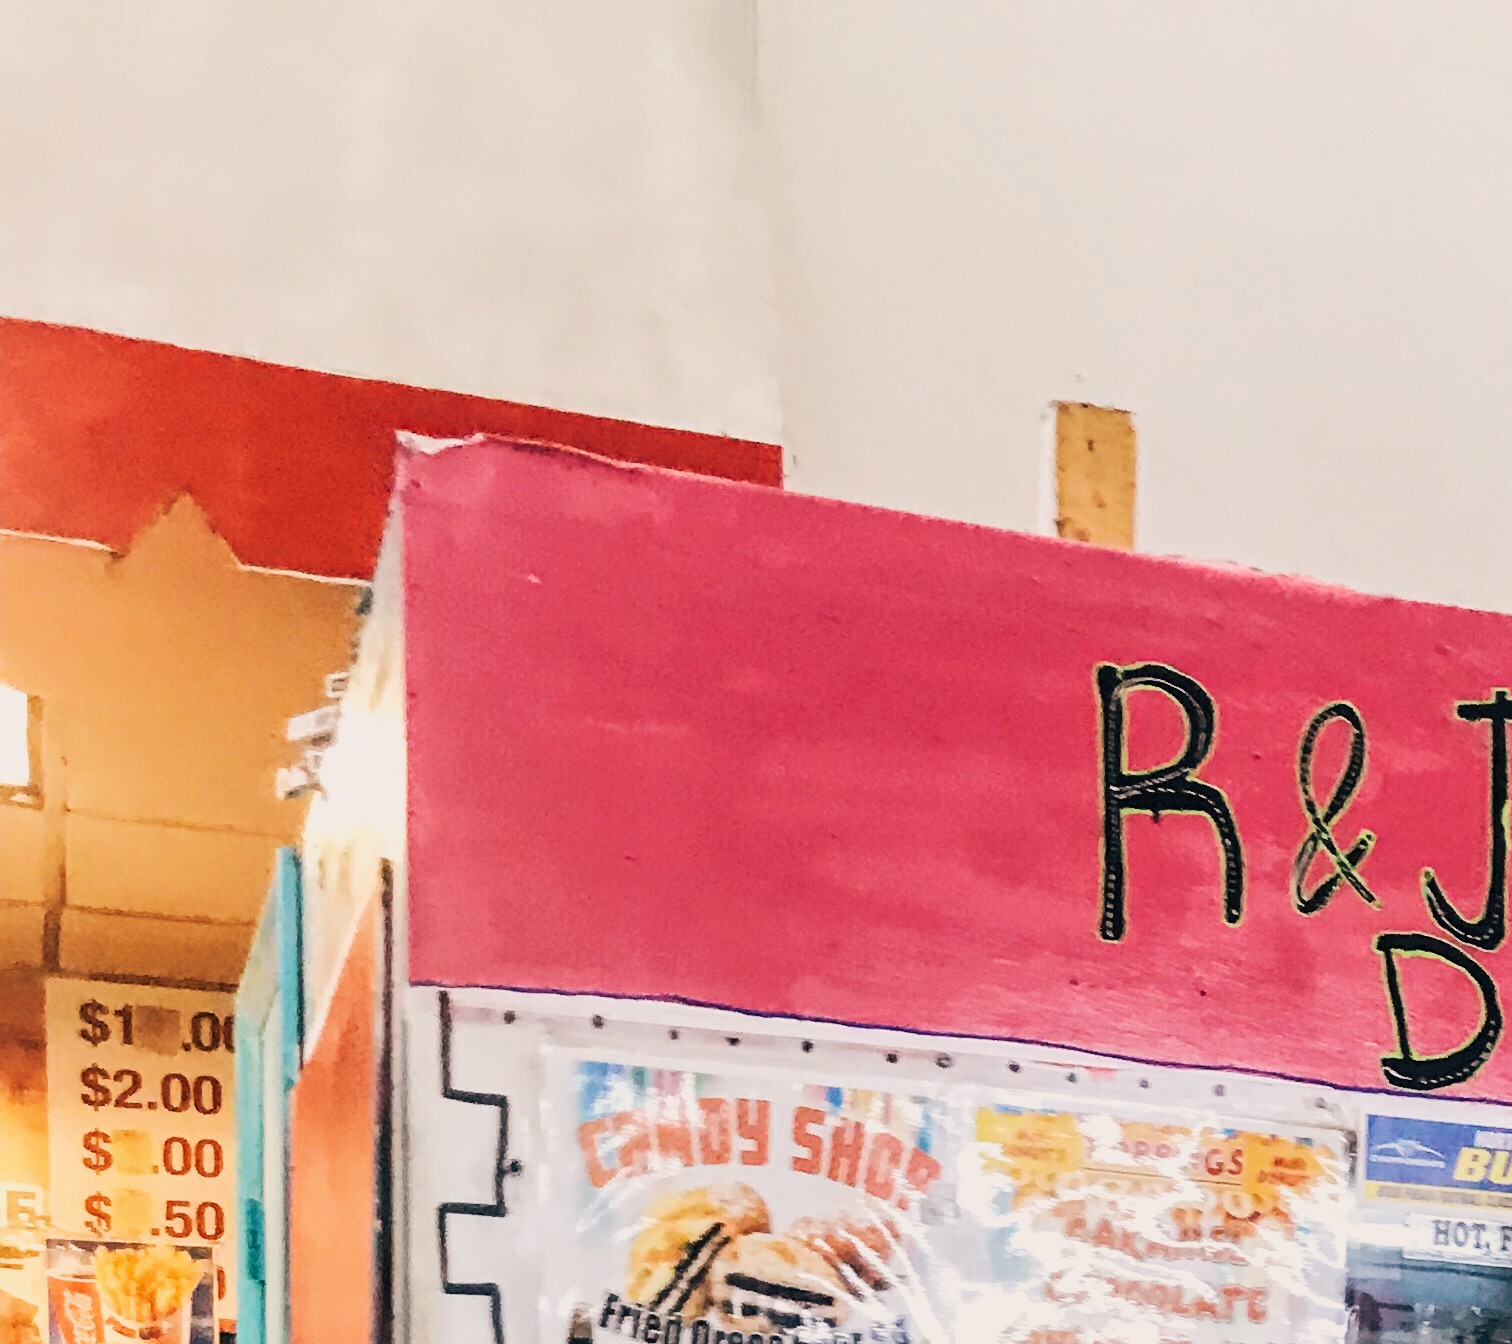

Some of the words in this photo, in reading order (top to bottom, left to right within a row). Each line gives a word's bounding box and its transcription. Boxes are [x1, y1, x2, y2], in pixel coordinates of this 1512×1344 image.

[81, 1063, 222, 1114] $2.00
[82, 1128, 224, 1178] $.00
[84, 1192, 225, 1240] $.50
[1432, 1219, 1491, 1250] HOT,
